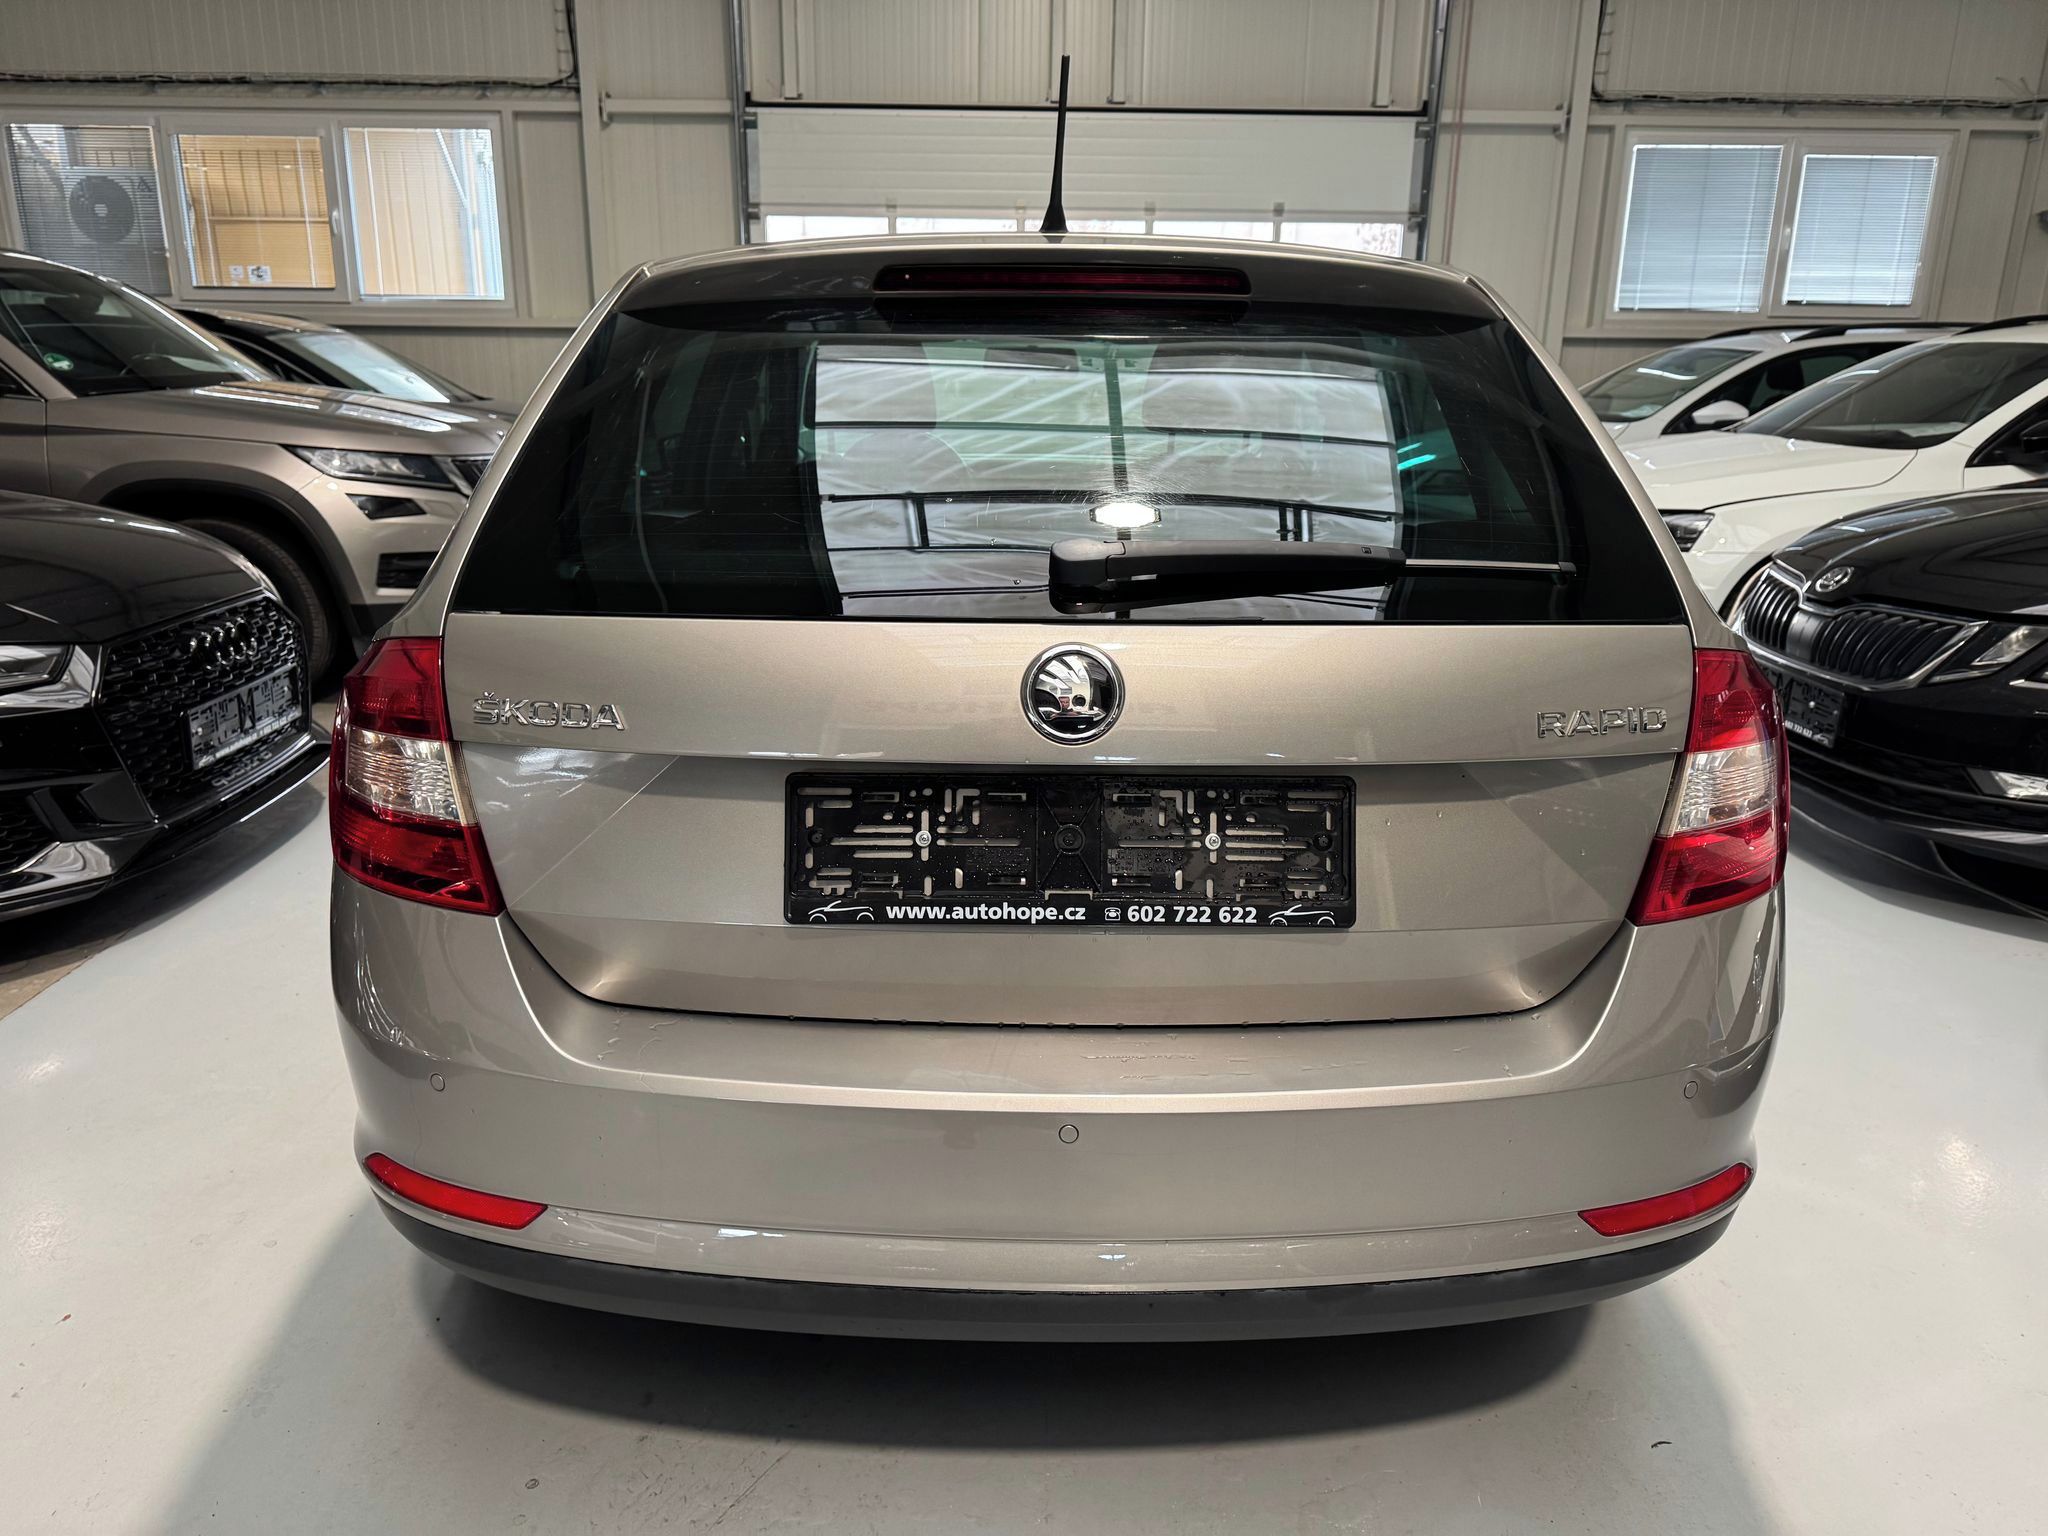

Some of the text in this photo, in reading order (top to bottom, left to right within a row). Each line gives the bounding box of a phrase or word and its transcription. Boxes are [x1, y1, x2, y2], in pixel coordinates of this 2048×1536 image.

[472, 691, 625, 730] ŠKODA
[1537, 706, 1667, 738] RAPID
[886, 902, 1258, 924] www.autohope.cz 602 722 622
